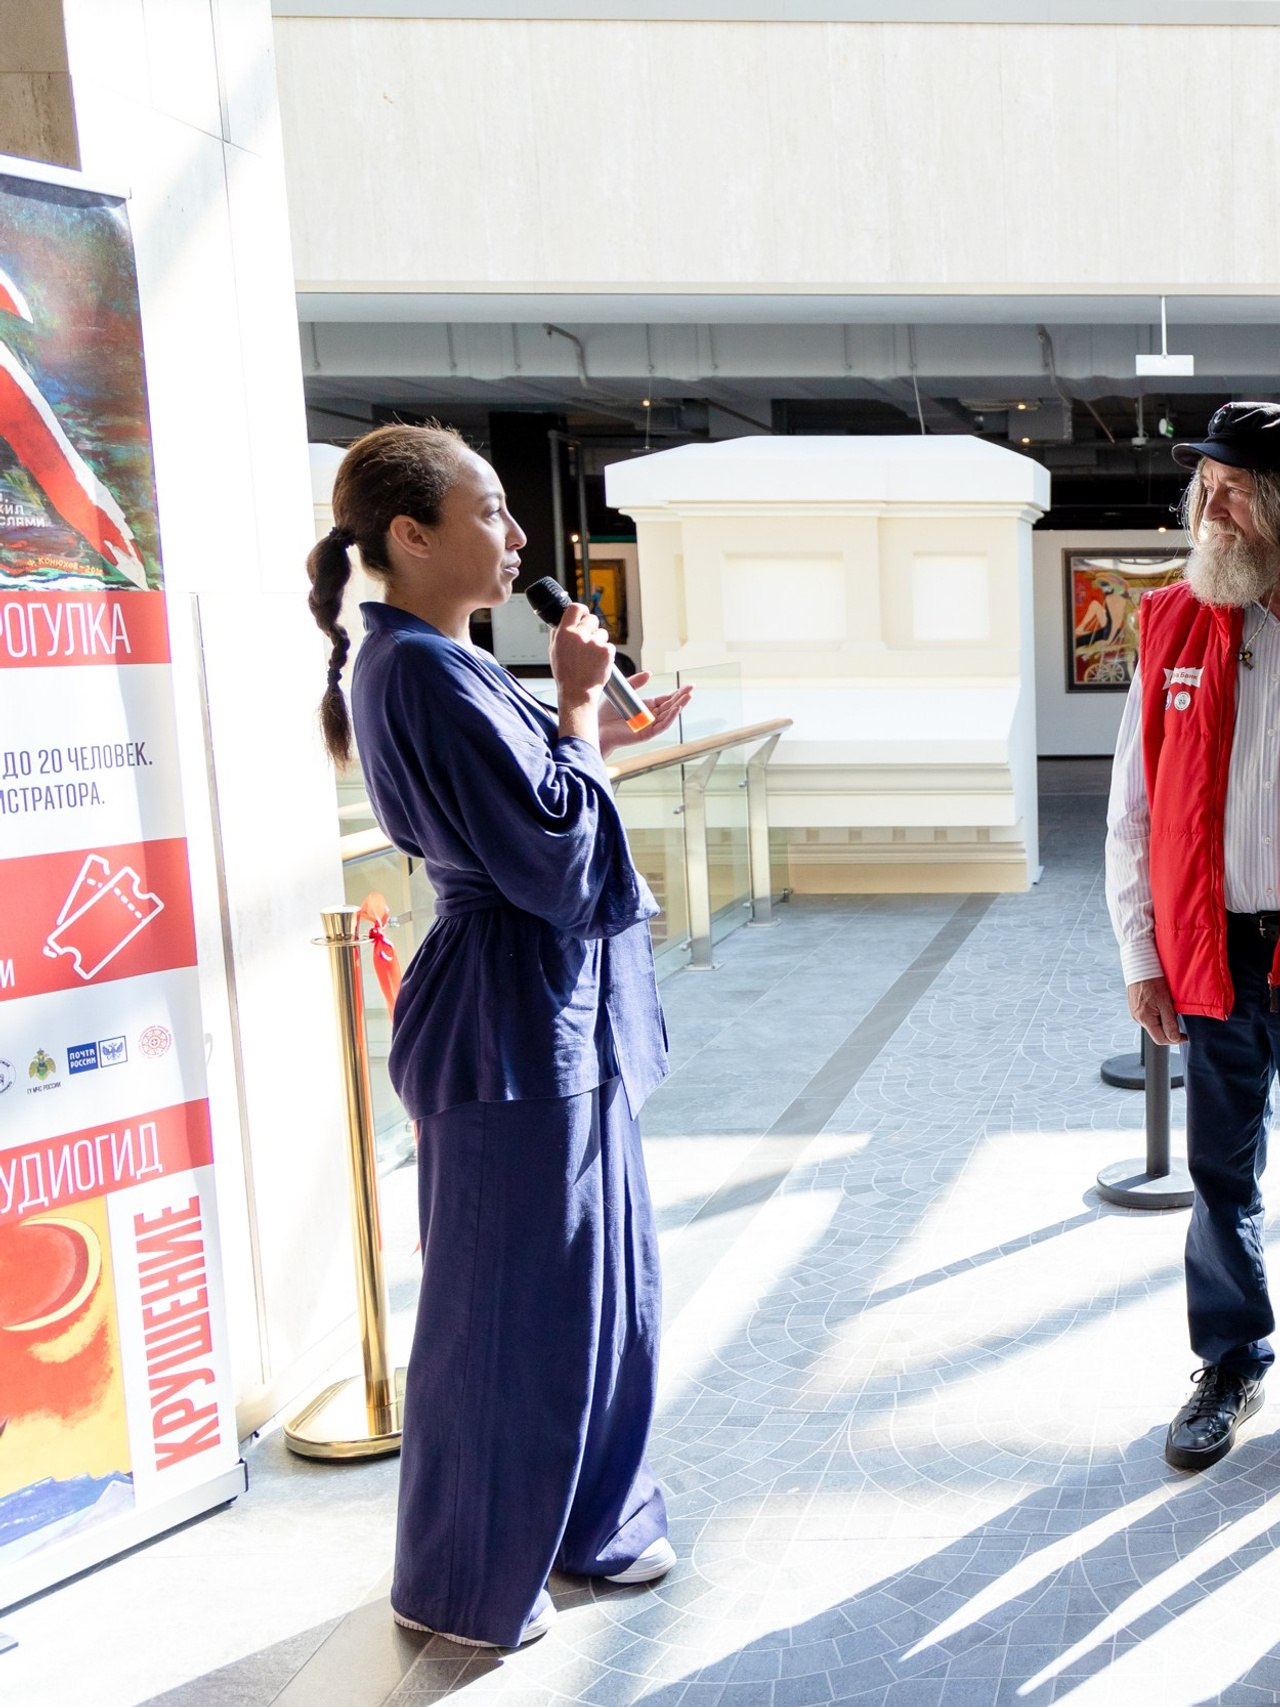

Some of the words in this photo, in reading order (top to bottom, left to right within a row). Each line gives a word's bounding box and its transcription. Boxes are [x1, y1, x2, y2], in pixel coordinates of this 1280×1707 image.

[0, 602, 131, 657] ОГУЛКА
[3, 751, 31, 779] ДО
[38, 749, 62, 774] 20
[68, 742, 153, 771] ЧЕЛОВЕК.
[70, 1049, 95, 1060] ПОЧТА
[71, 1057, 97, 1069] РОССИИ
[0, 1122, 162, 1214] УДИОГИД
[133, 1195, 221, 1472] КРУШЕНИЕ
